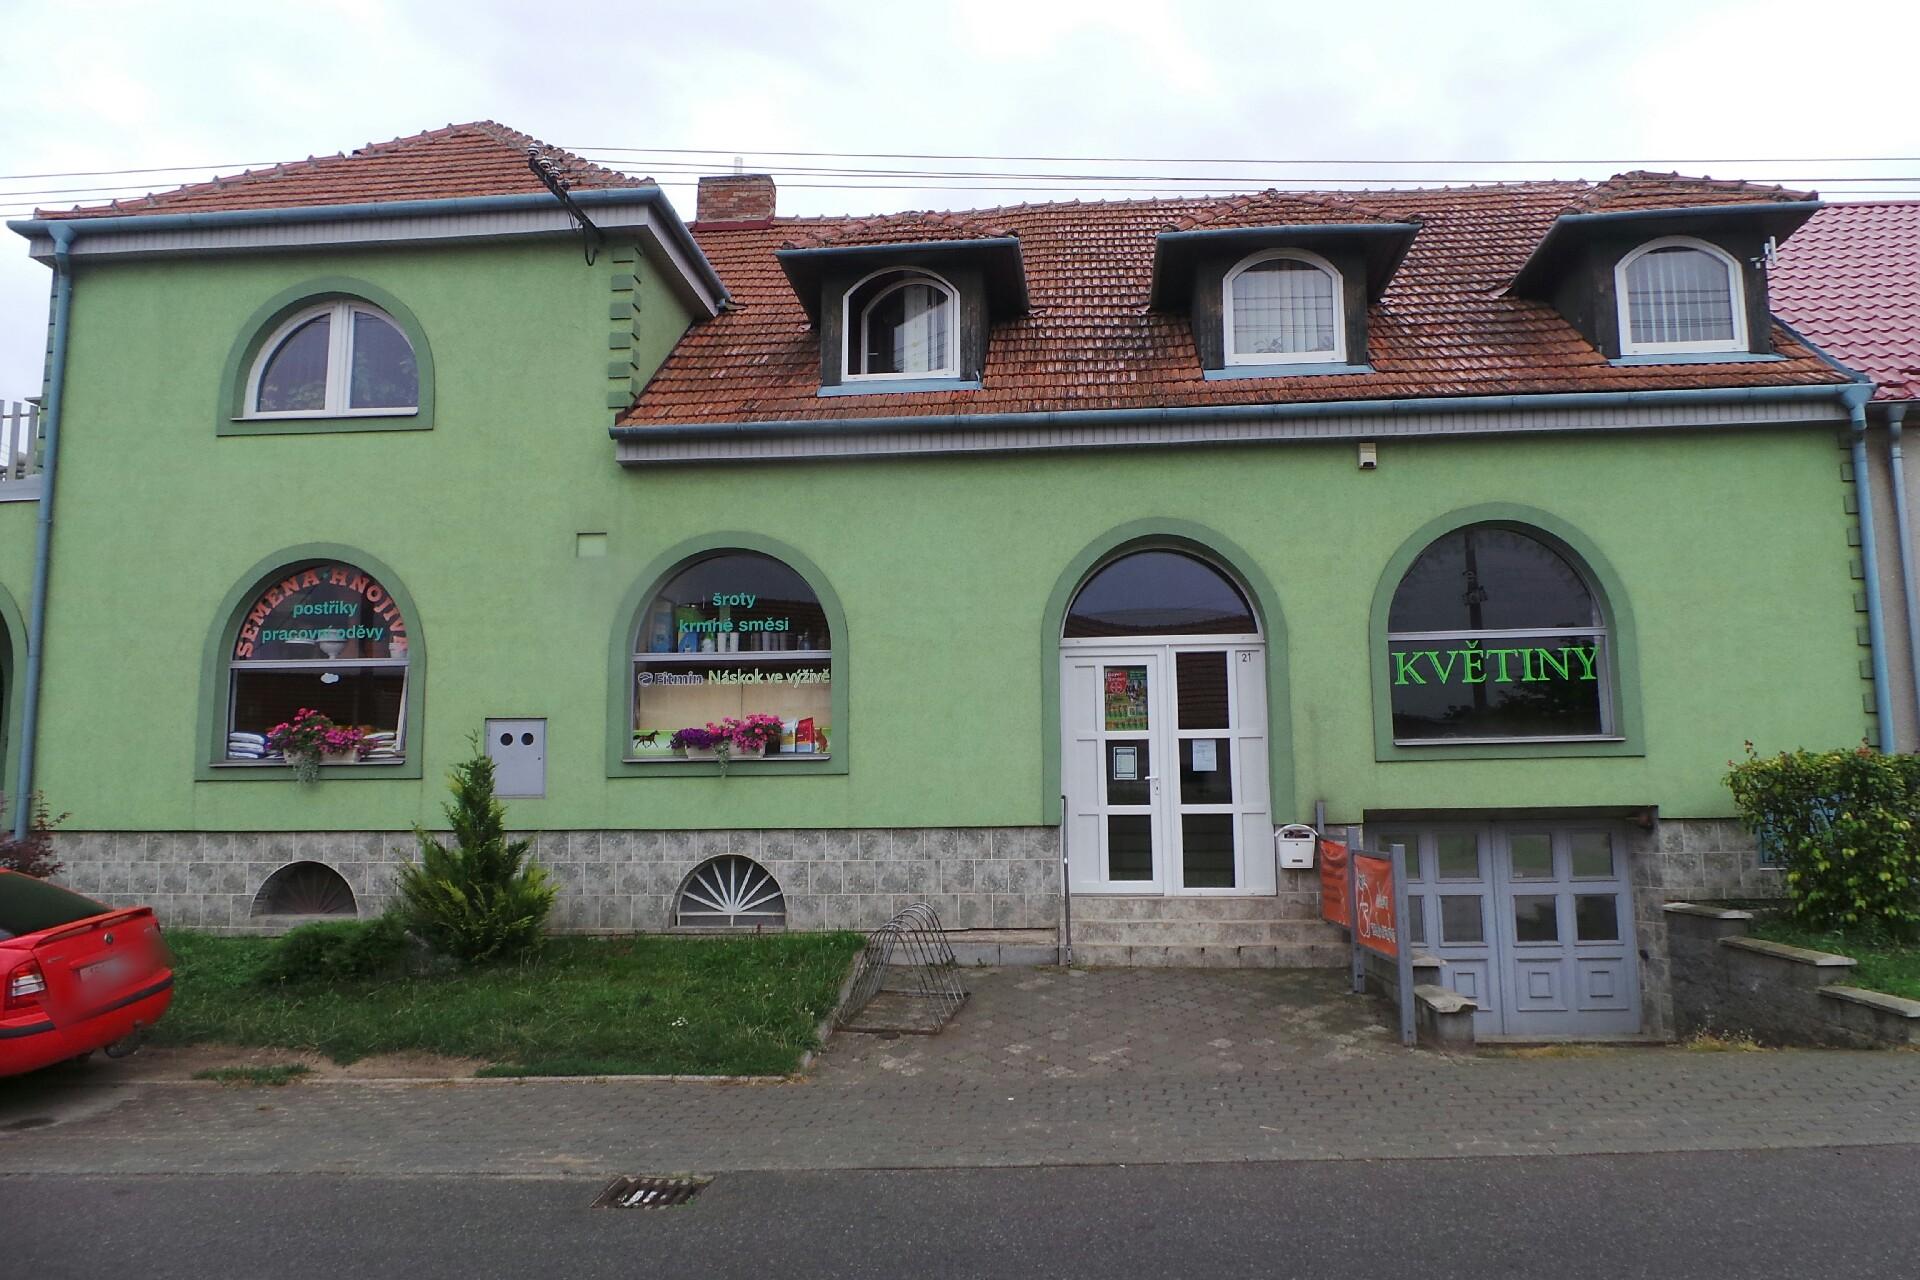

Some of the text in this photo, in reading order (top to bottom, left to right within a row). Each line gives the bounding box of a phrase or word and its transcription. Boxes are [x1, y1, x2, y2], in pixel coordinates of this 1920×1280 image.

[712, 592, 756, 608] šroty
[236, 570, 320, 657] SEMENA
[293, 601, 358, 618] postřiky
[262, 624, 384, 643] pracovní oděvy
[679, 617, 789, 633] krmné směsi
[1241, 652, 1251, 663] 21
[1392, 640, 1599, 684] KVĚTINY
[655, 668, 830, 688] Fitmin Náskok ve výživě
